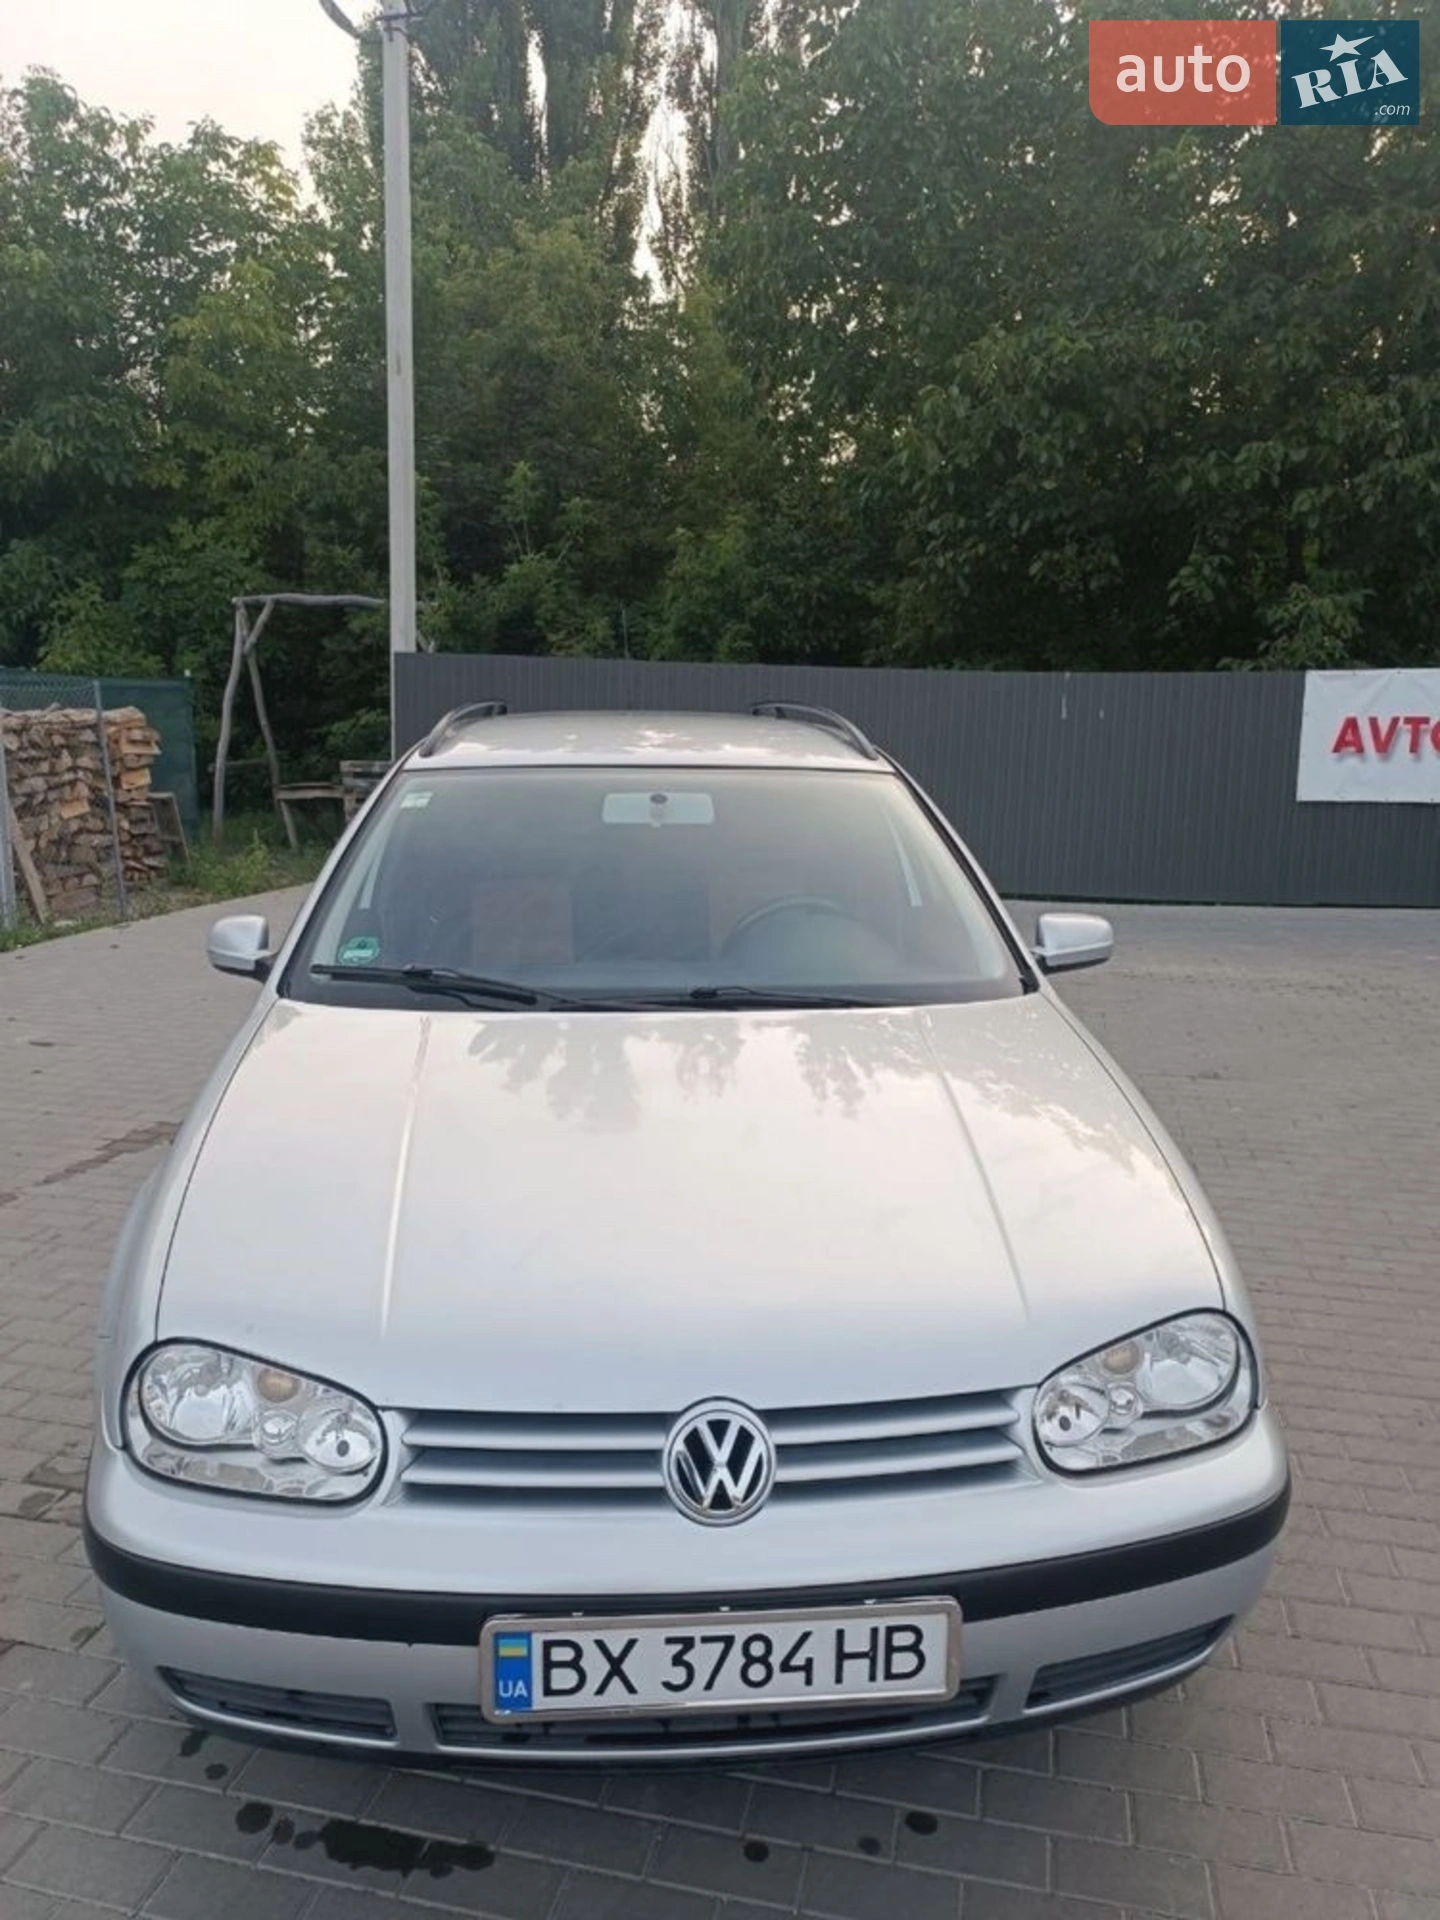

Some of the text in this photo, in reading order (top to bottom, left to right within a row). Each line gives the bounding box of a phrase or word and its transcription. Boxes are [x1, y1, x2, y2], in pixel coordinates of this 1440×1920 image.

[541, 1624, 926, 1697] BX 3784 HB
[499, 1681, 527, 1699] UA
